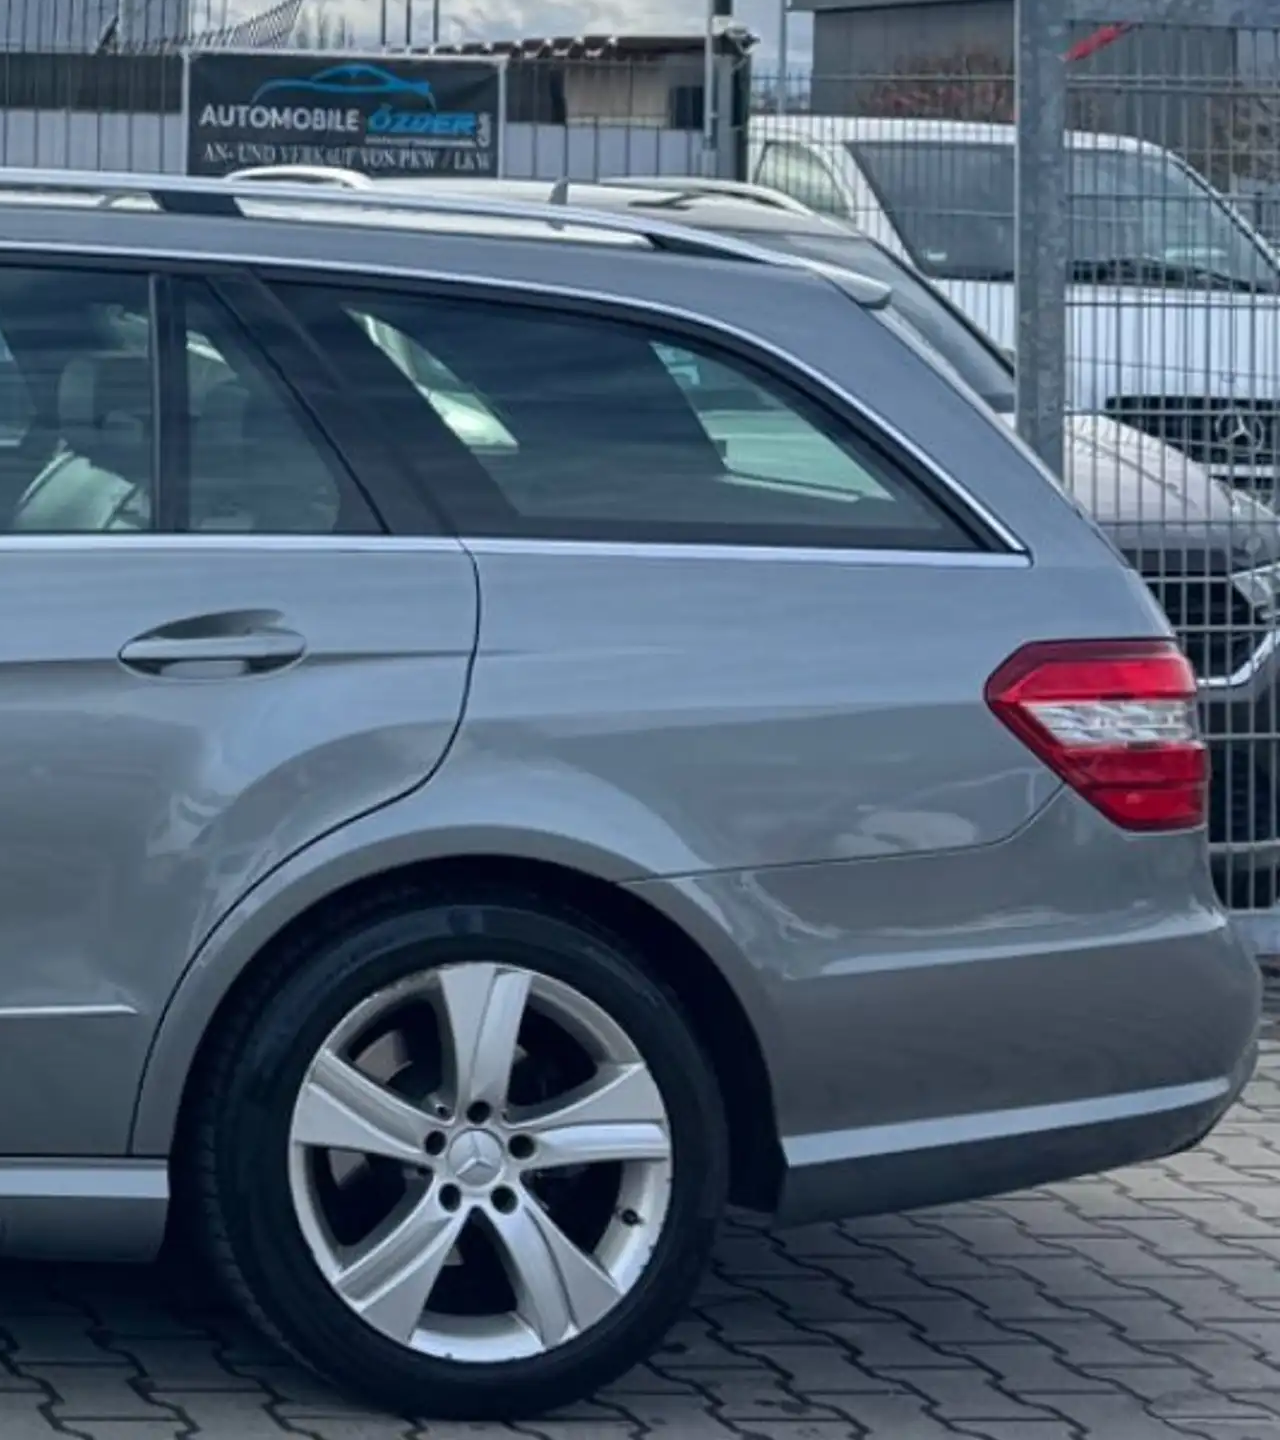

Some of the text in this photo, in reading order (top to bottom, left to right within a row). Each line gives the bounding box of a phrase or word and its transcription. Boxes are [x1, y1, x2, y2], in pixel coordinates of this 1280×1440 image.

[199, 104, 360, 132] AUTOMOBILE
[204, 142, 235, 163] AN-
[237, 142, 277, 164] UND
[360, 147, 396, 168] VON
[398, 147, 437, 169] PKW
[453, 150, 492, 171] LKW
